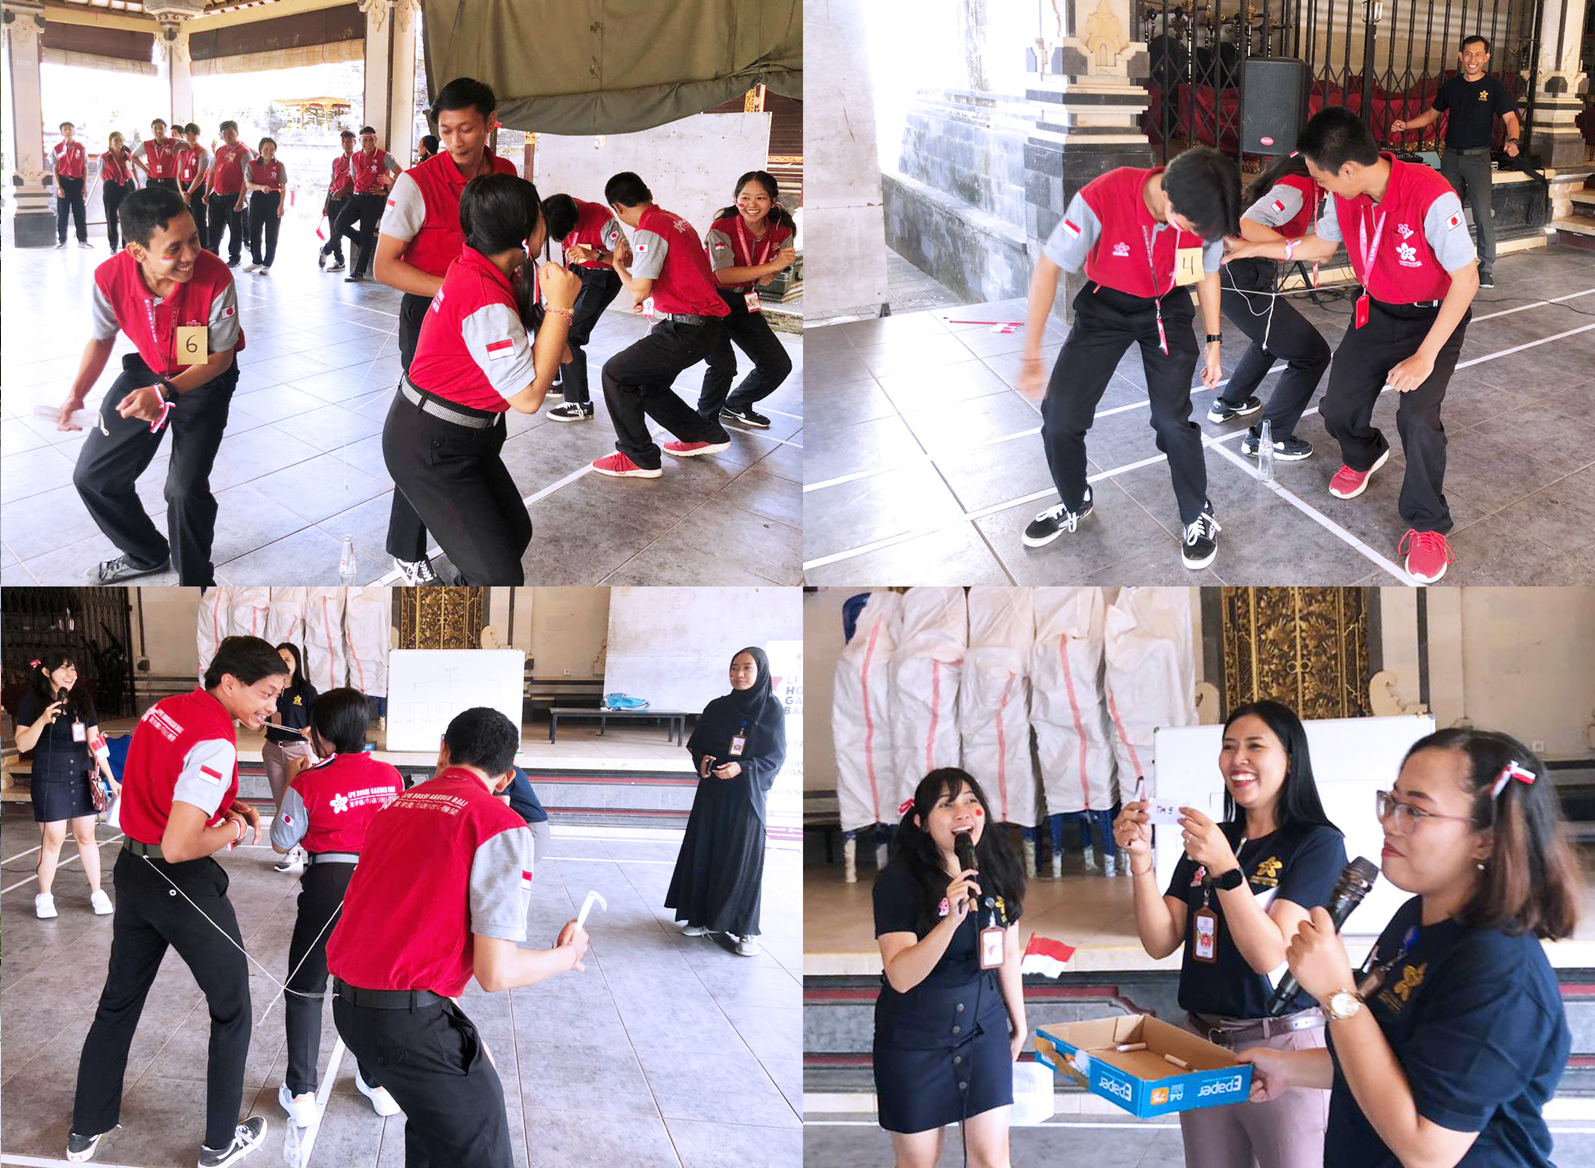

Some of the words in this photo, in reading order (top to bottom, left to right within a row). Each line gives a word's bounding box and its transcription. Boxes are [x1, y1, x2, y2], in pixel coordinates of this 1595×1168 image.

[1183, 255, 1194, 275] 4
[186, 334, 198, 353] 6
[1098, 1077, 1132, 1102] Epaper
[1197, 1075, 1243, 1097] Epaper
